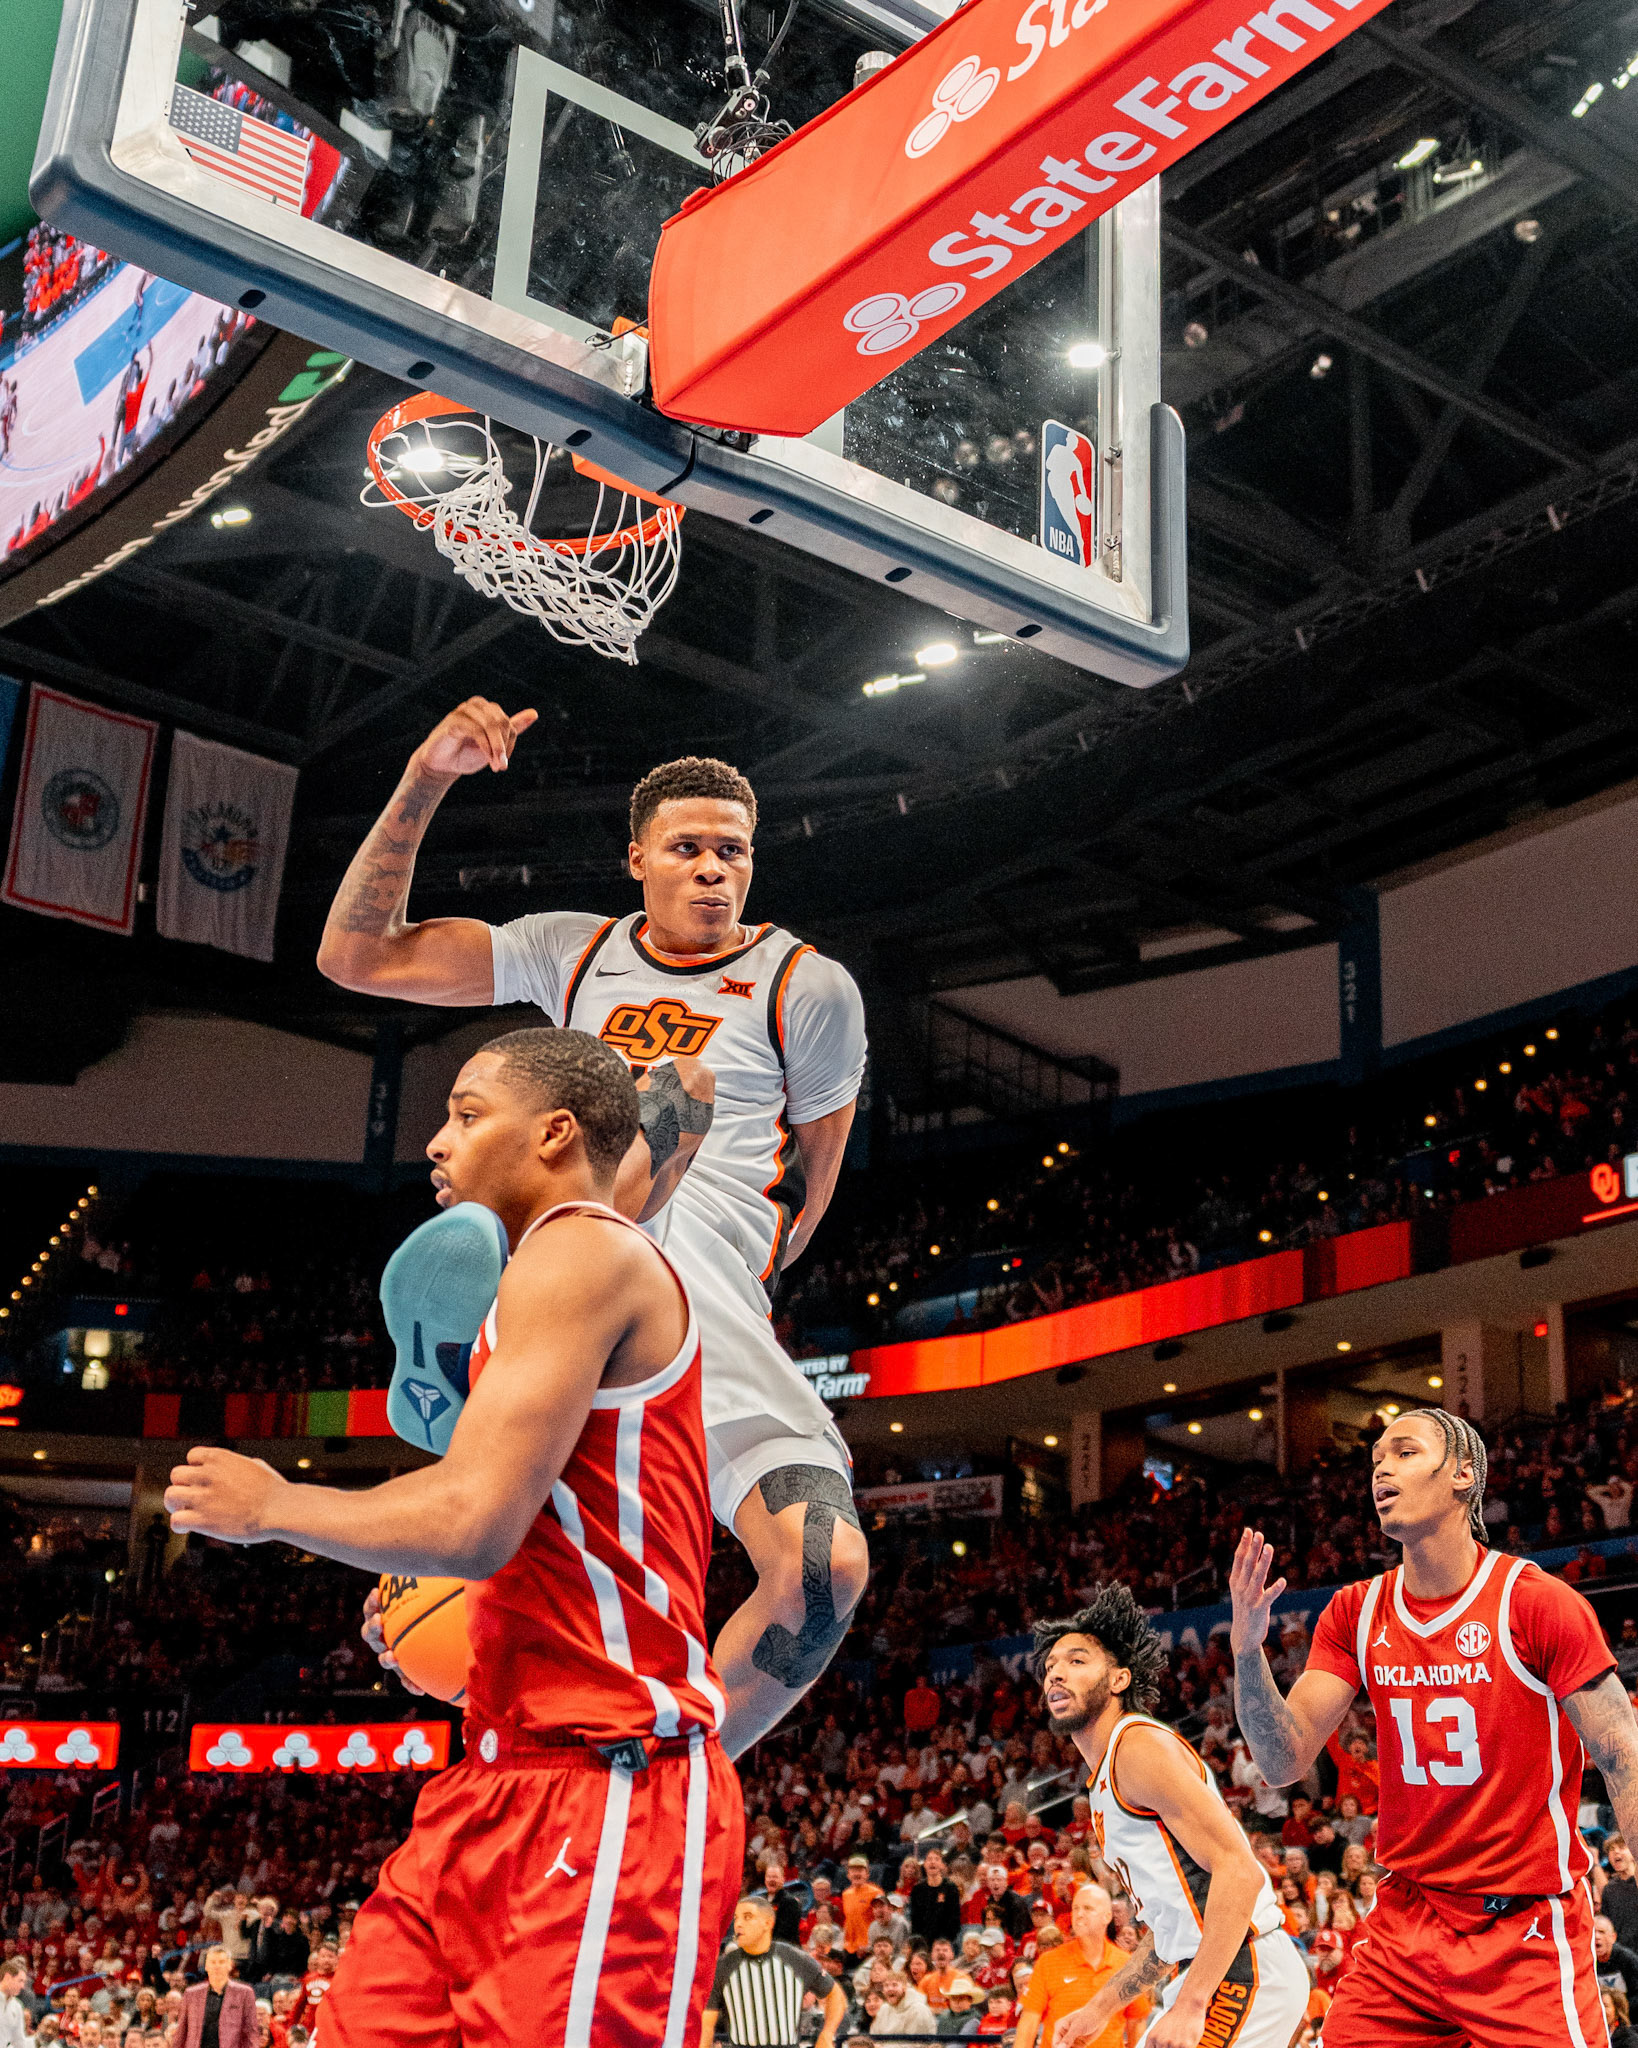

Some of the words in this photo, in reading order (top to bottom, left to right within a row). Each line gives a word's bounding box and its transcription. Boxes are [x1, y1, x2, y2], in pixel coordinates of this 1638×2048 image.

[1006, 0, 1108, 82] Sta
[1050, 526, 1075, 558] NBA
[1343, 960, 1356, 1024] 321
[600, 999, 720, 1062] OSU
[829, 1354, 849, 1373] BY
[811, 1372, 871, 1399] Farm
[381, 1576, 418, 1614] CAA
[1459, 1623, 1489, 1654] SEC
[1374, 1662, 1492, 1687] OKLAHOMA
[143, 1709, 179, 1733] 112
[1389, 1697, 1483, 1786] 13
[1196, 1981, 1248, 2048] WBOYS
